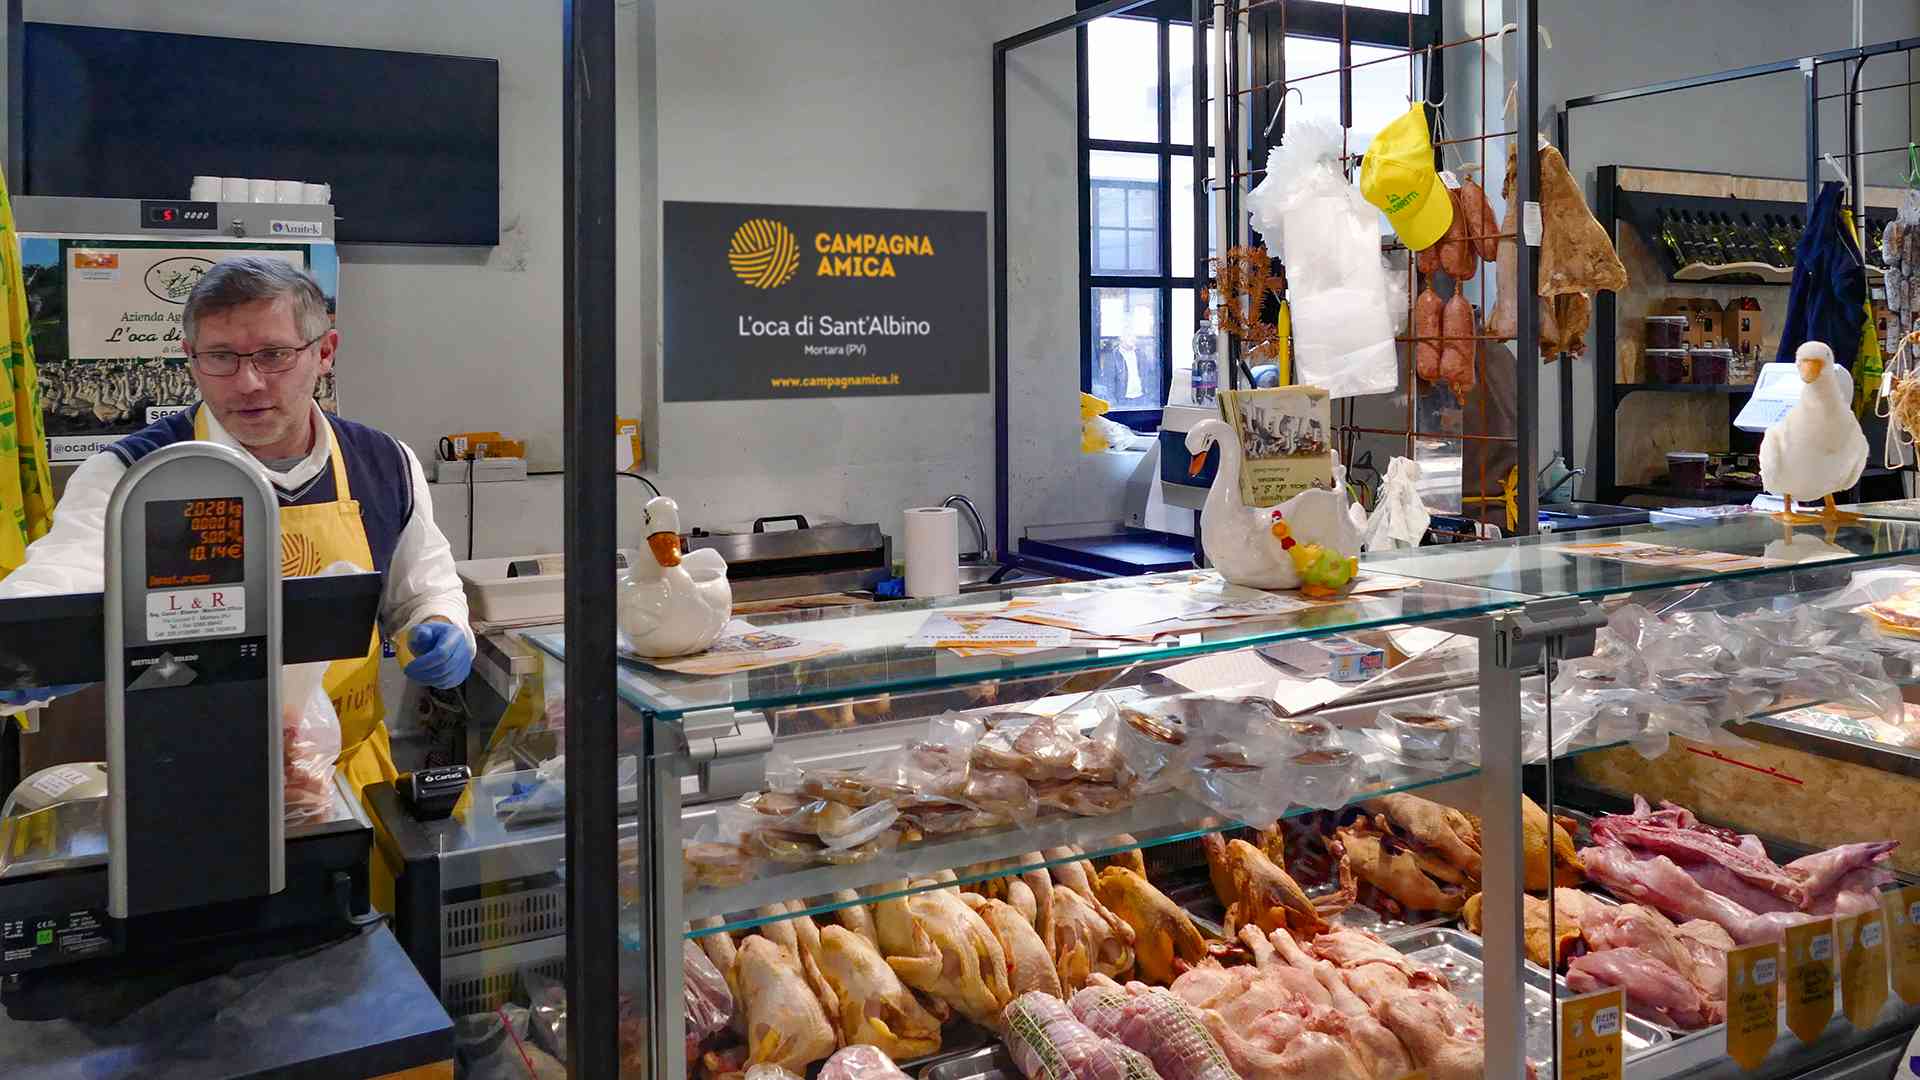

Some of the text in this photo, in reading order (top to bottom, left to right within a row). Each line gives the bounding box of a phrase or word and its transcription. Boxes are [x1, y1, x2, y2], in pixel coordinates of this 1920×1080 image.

[284, 220, 321, 235] Amitek
[815, 232, 935, 256] CAMPAGNA
[816, 255, 897, 278] AMICA
[120, 311, 184, 326] Azienda Ag
[738, 315, 931, 336] L'oca di Sant'Albino
[105, 327, 183, 343] L'oca di
[804, 343, 867, 357] Mortara (PV)
[771, 373, 901, 390] www.campagnamica.it
[54, 441, 110, 454] @ocadis
[168, 592, 225, 611] L & R
